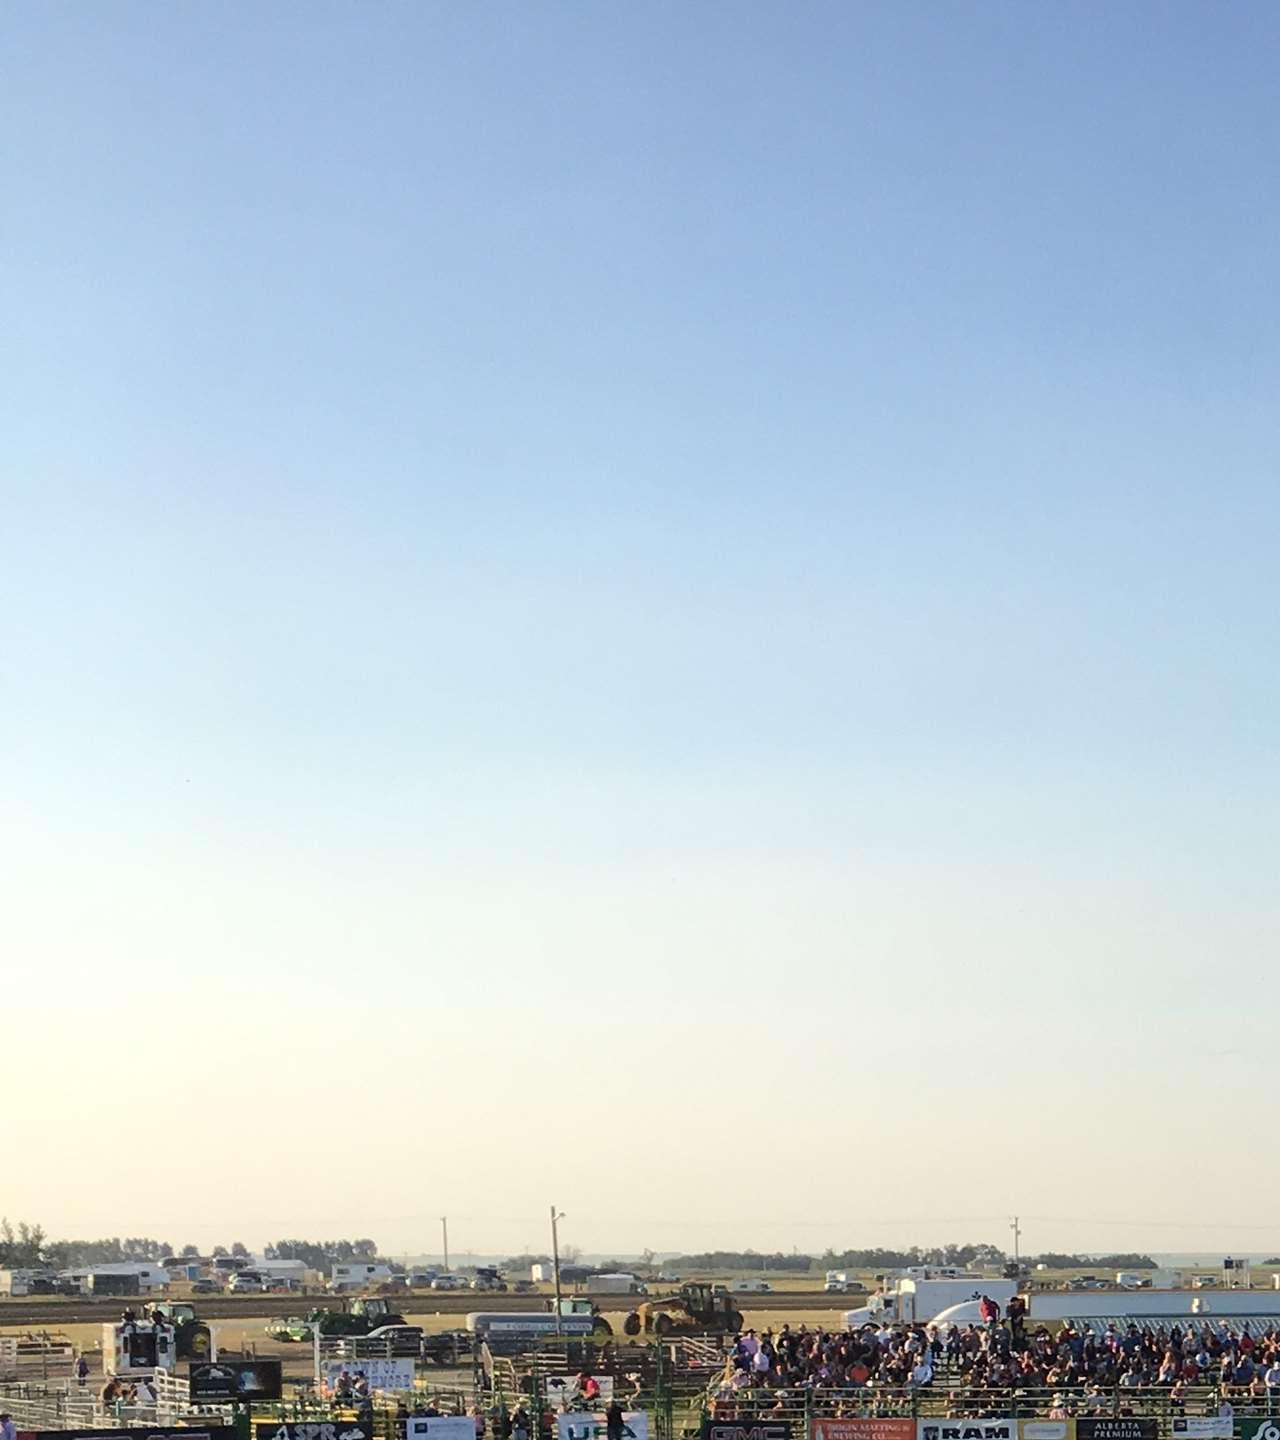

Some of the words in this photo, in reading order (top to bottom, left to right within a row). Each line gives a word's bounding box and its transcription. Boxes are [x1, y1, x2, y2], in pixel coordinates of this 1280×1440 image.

[1095, 1422, 1140, 1430] ALBERTA
[942, 1427, 1010, 1440] RAM
[1094, 1430, 1142, 1438] PREMIUM
